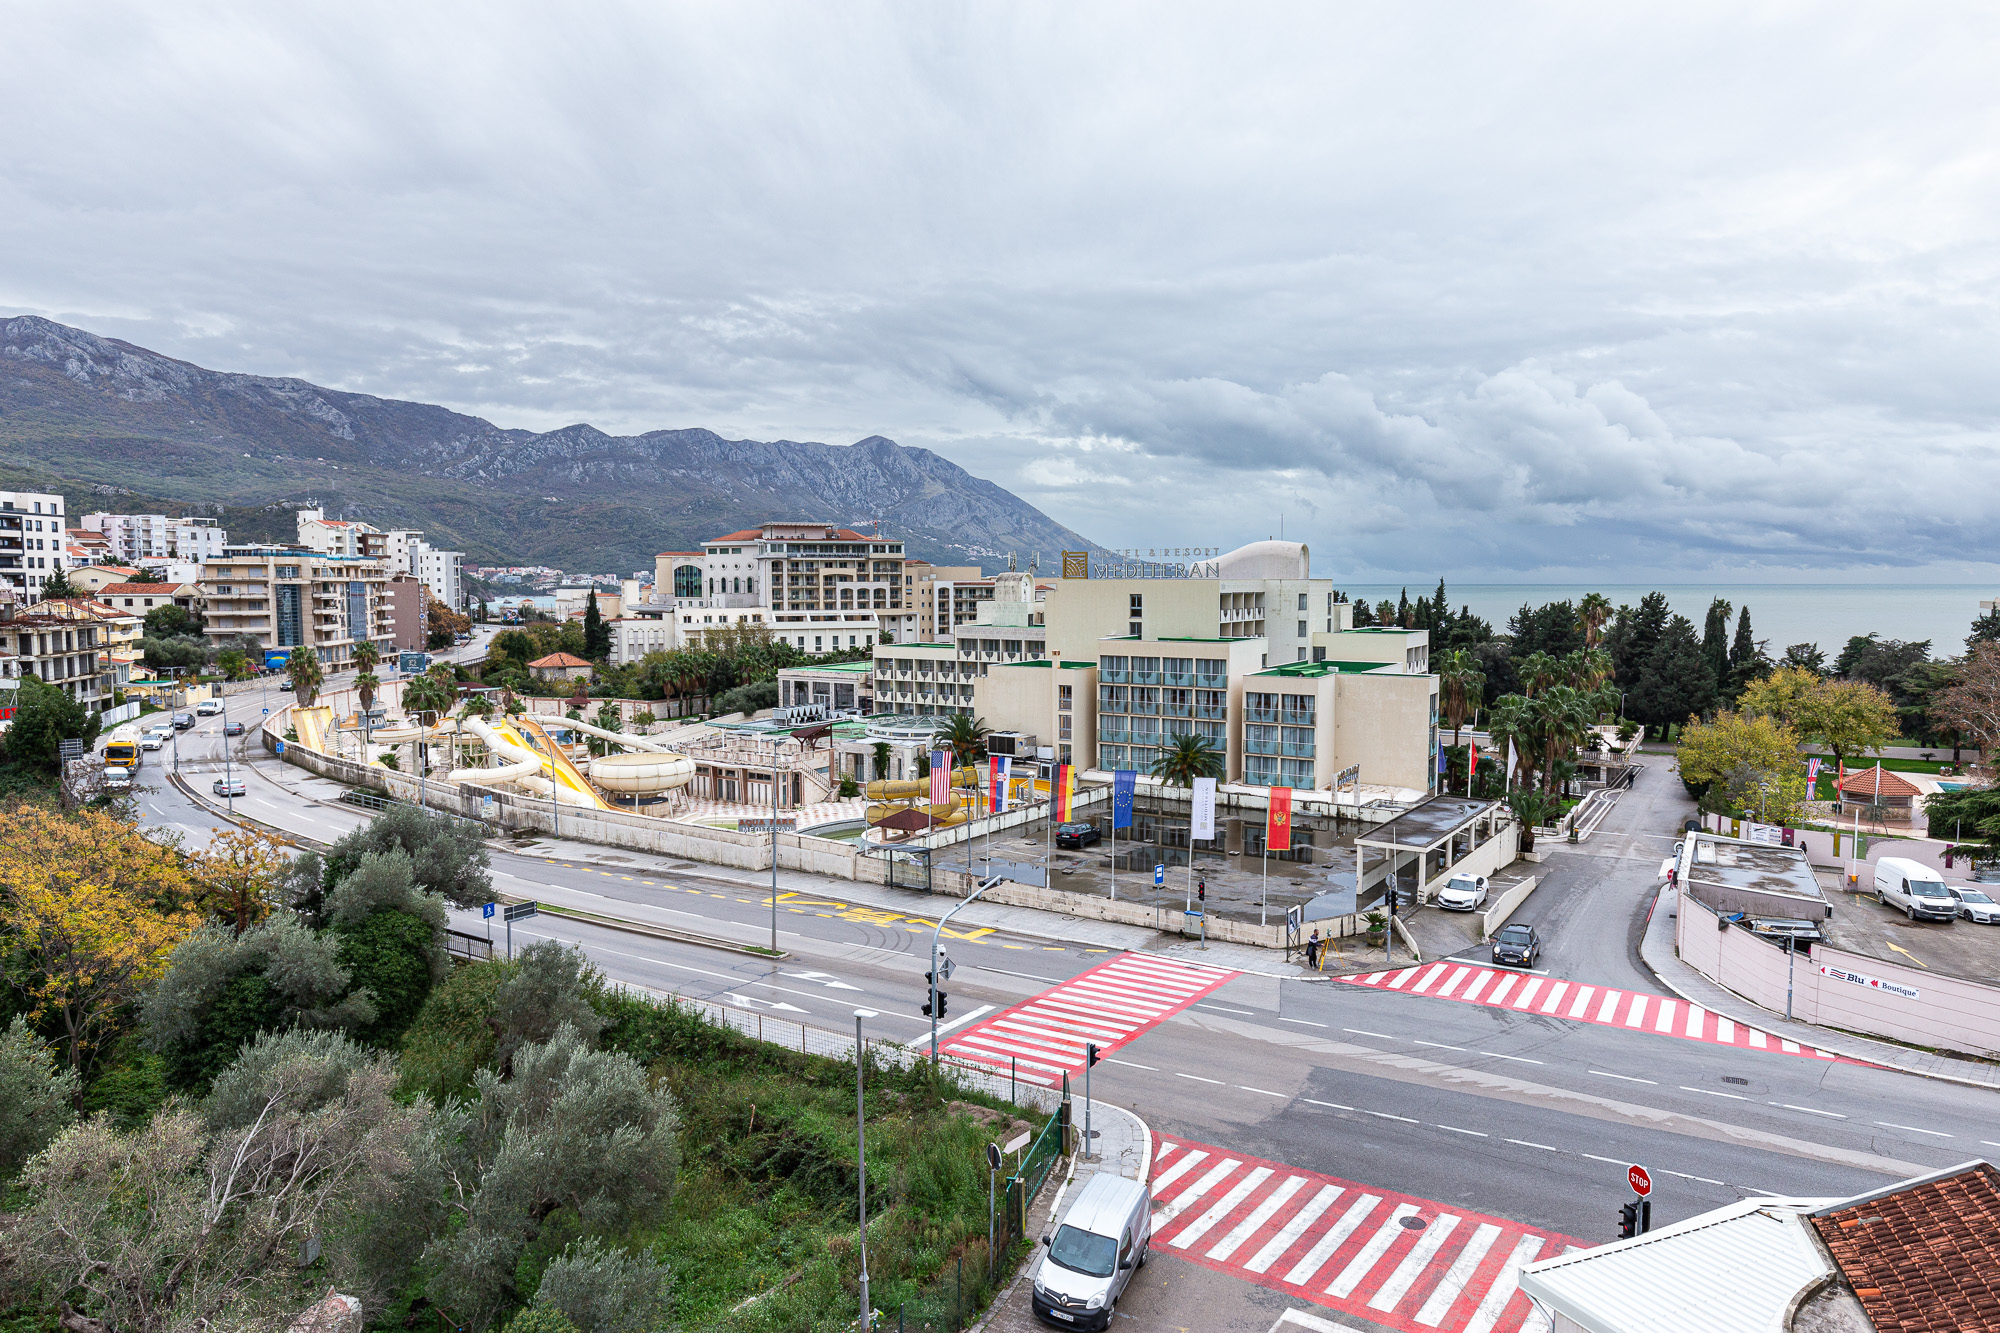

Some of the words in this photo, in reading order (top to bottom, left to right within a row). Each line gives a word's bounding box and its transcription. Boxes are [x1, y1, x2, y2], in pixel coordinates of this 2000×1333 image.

[1094, 549, 1140, 558] HOTEL
[1149, 548, 1156, 557] &
[1164, 548, 1219, 557] RESORT
[1093, 563, 1219, 578] MEDITERAN
[739, 819, 765, 827] AQUA
[1847, 973, 1864, 985] Blu
[1882, 982, 1917, 997] Boutique
[1631, 1172, 1649, 1189] STOP
